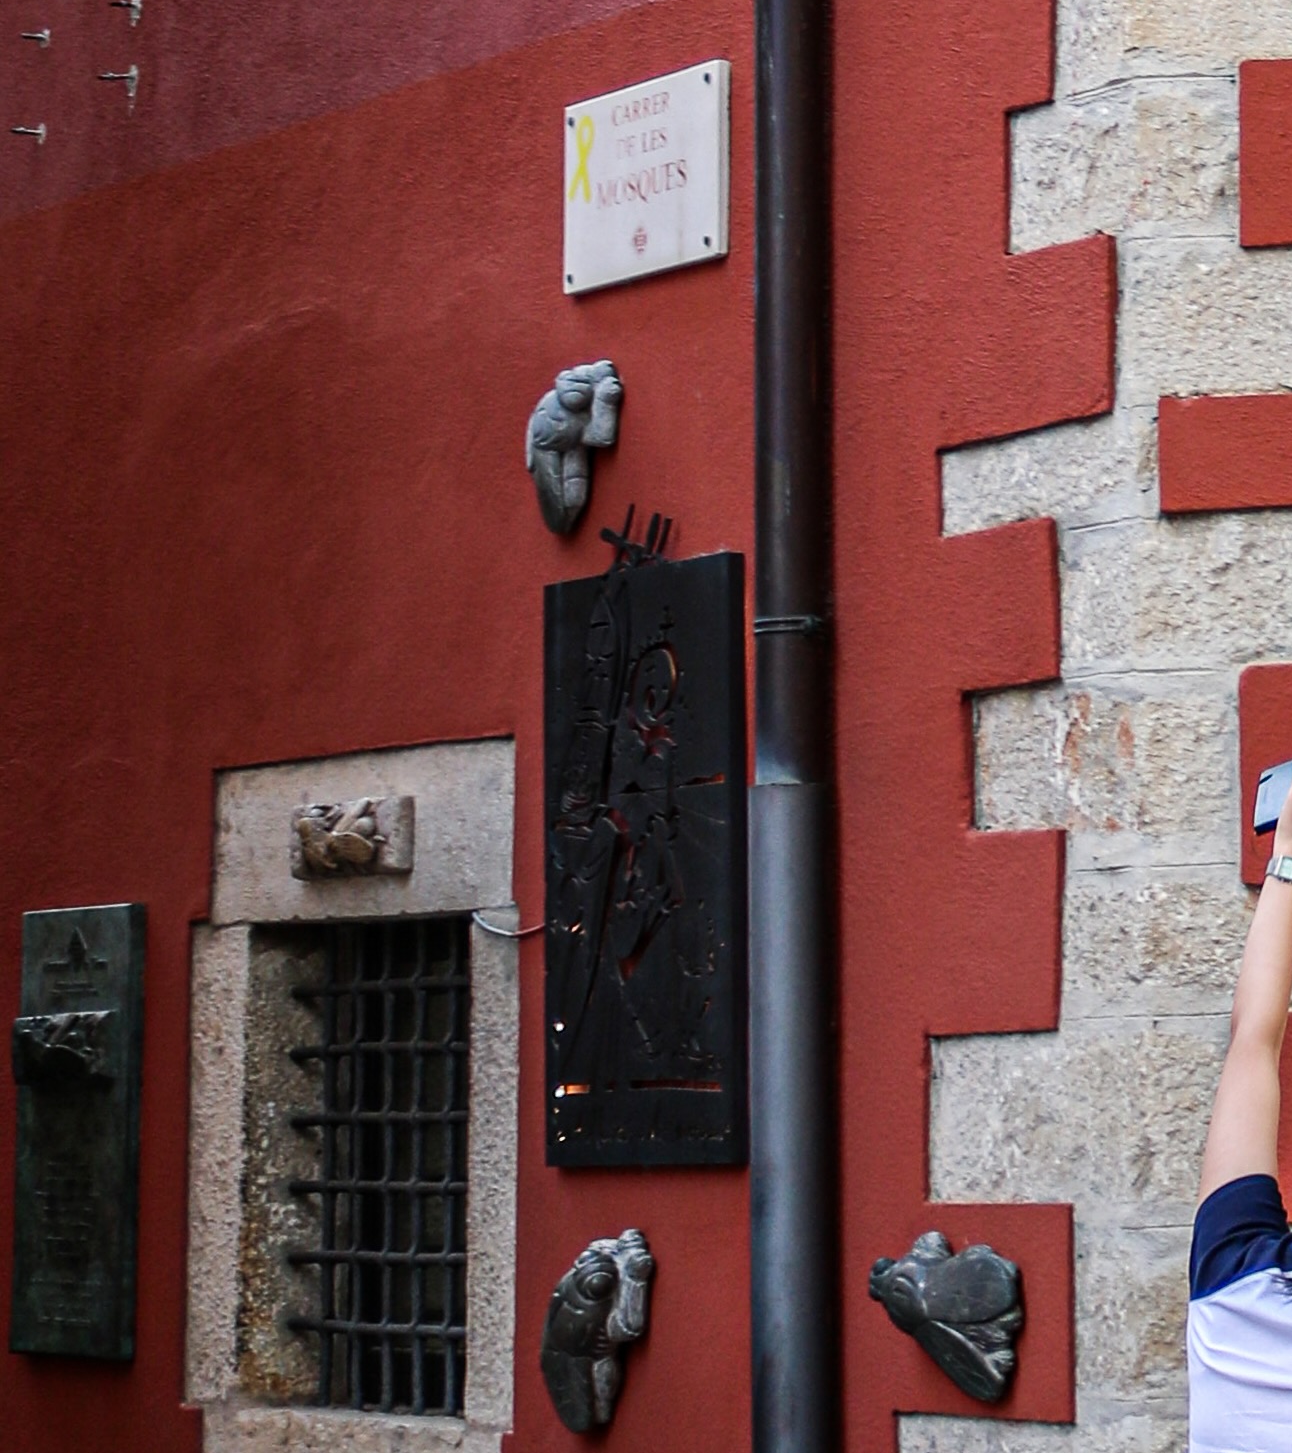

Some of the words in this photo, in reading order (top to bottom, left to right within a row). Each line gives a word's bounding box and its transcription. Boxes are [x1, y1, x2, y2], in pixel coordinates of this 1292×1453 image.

[611, 91, 670, 126] CARRER
[641, 127, 668, 153] LES
[596, 158, 688, 209] MOSQUES
